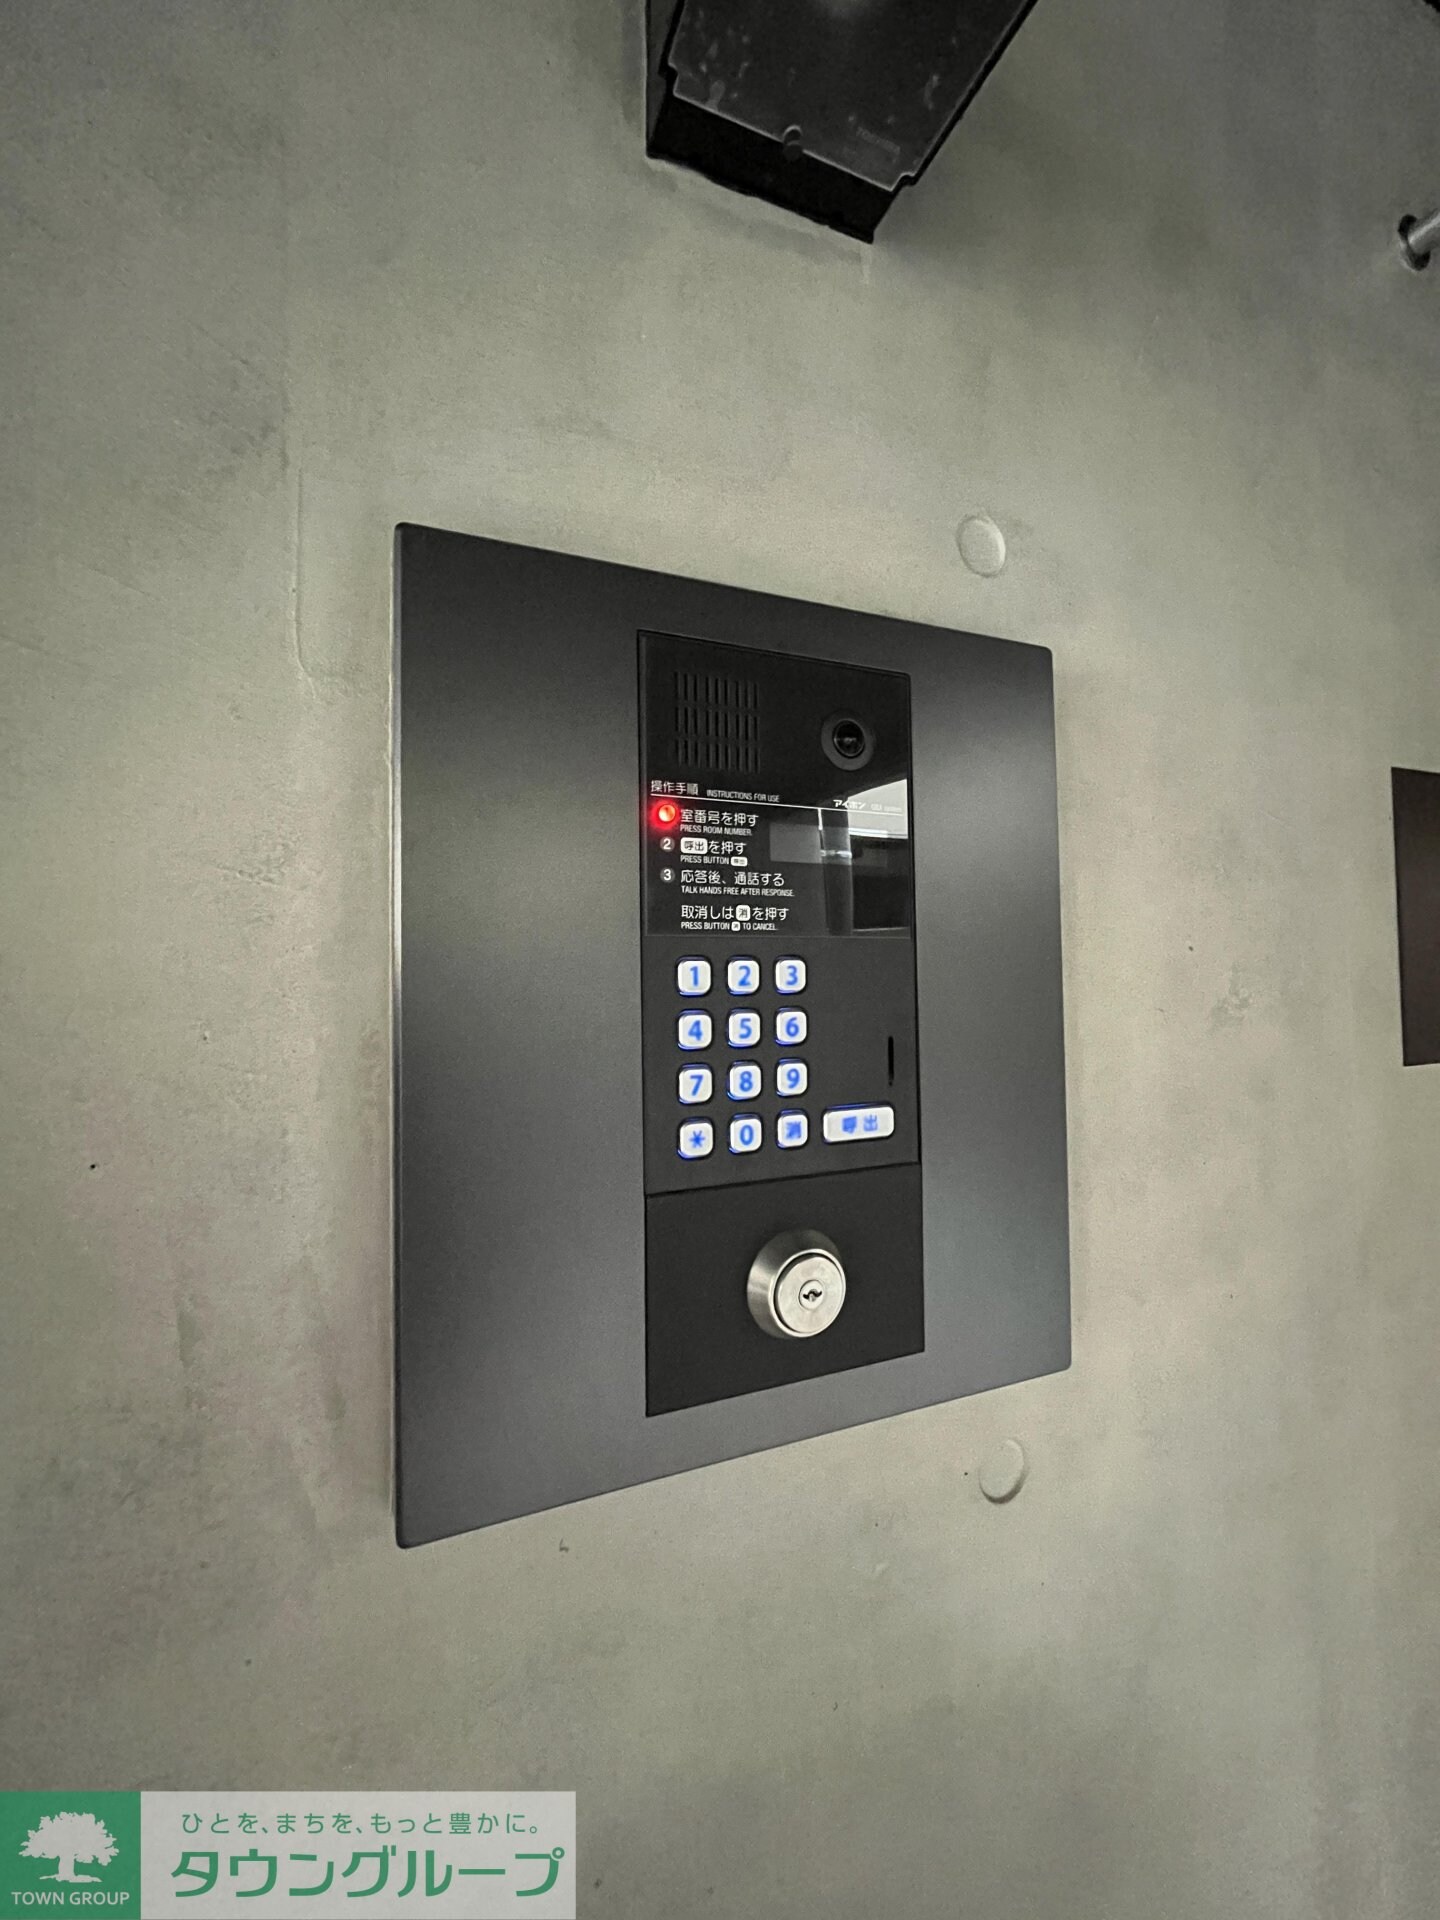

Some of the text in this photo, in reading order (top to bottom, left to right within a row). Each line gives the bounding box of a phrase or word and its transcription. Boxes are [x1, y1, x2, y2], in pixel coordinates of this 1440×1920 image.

[651, 780, 699, 796] 操作手順
[706, 789, 753, 801] INSTRUCTIONS
[753, 793, 767, 801] FOR
[681, 808, 759, 827] 室番号を押す
[680, 824, 702, 833] PRESS
[703, 826, 724, 834] ROOM
[663, 838, 672, 850] 2
[680, 855, 702, 864] PRESS
[703, 857, 730, 865] BUTTON
[663, 868, 672, 881] 3
[681, 886, 698, 894] TALK
[699, 886, 722, 895] HANDS
[723, 887, 739, 896] FREE
[740, 888, 761, 896] AFTER
[680, 922, 703, 930] PRESS
[704, 922, 730, 931] BUTTON
[743, 923, 752, 931] TO
[689, 966, 699, 987] 1
[738, 965, 751, 987] 2
[786, 965, 798, 986] 3
[688, 1019, 703, 1041] 4
[738, 1018, 752, 1039] 5
[785, 1017, 799, 1037] 6
[690, 1074, 703, 1096] 7
[739, 1070, 753, 1092] 8
[786, 1068, 800, 1089] 9
[740, 1124, 753, 1146] 0
